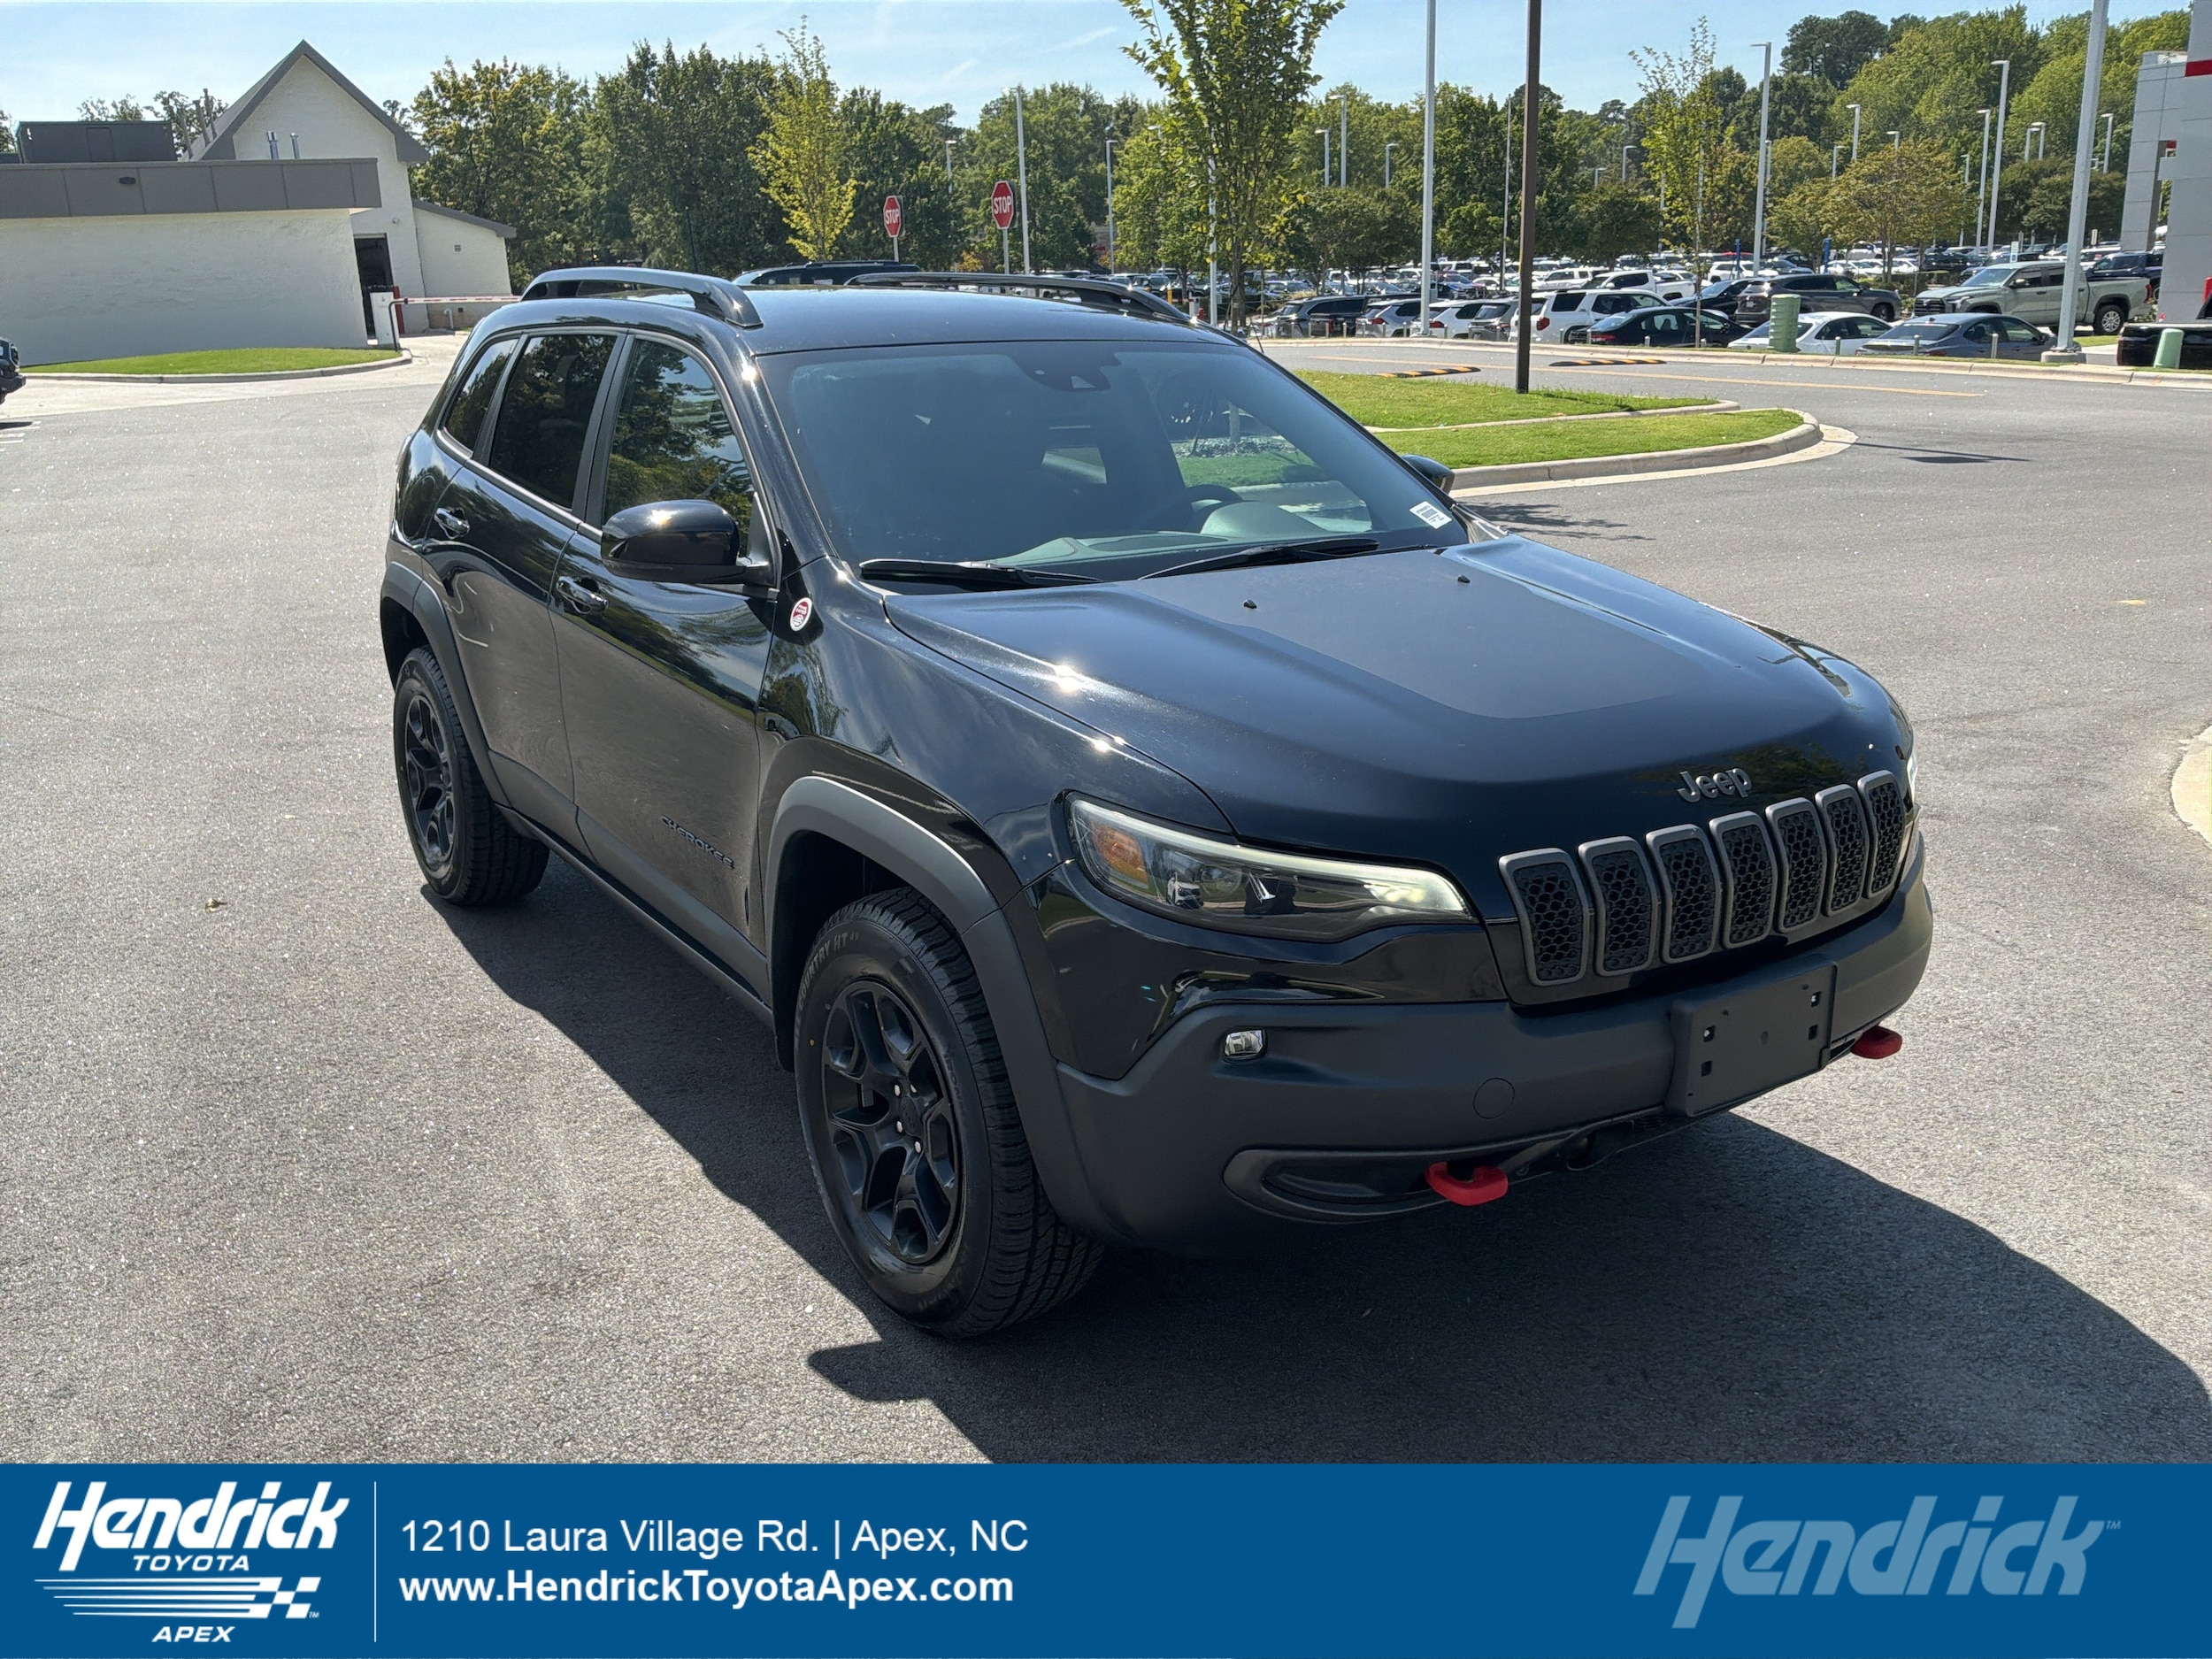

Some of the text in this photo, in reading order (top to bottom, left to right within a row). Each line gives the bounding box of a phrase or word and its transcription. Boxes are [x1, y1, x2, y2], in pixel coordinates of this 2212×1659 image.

[885, 209, 900, 224] STOP
[994, 196, 1011, 214] STOP
[1677, 767, 1752, 803] Jeep
[659, 815, 735, 869] CHEROKEE
